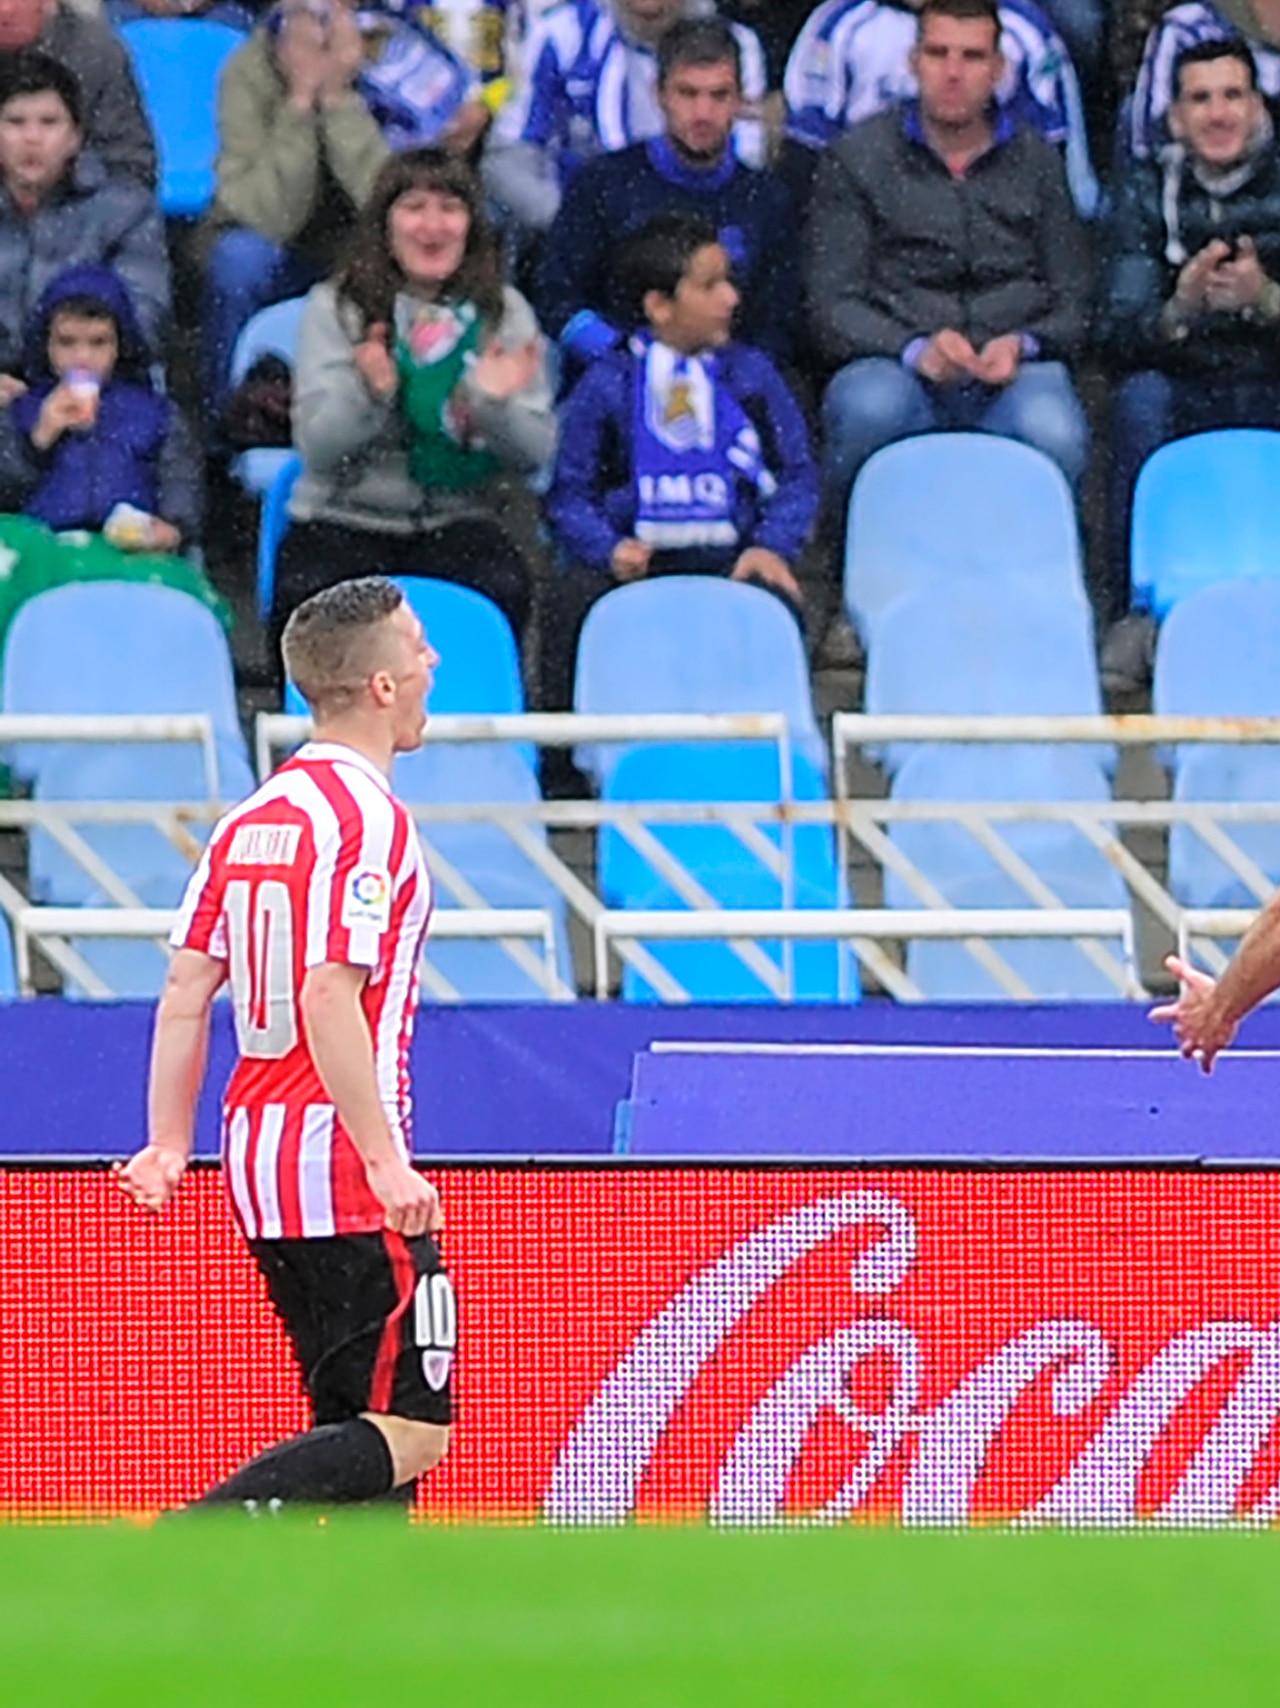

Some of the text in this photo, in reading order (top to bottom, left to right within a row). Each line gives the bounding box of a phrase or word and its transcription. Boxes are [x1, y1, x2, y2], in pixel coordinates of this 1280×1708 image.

[638, 472, 728, 507] IMQ
[223, 879, 299, 1060] 10
[414, 1272, 457, 1347] 10
